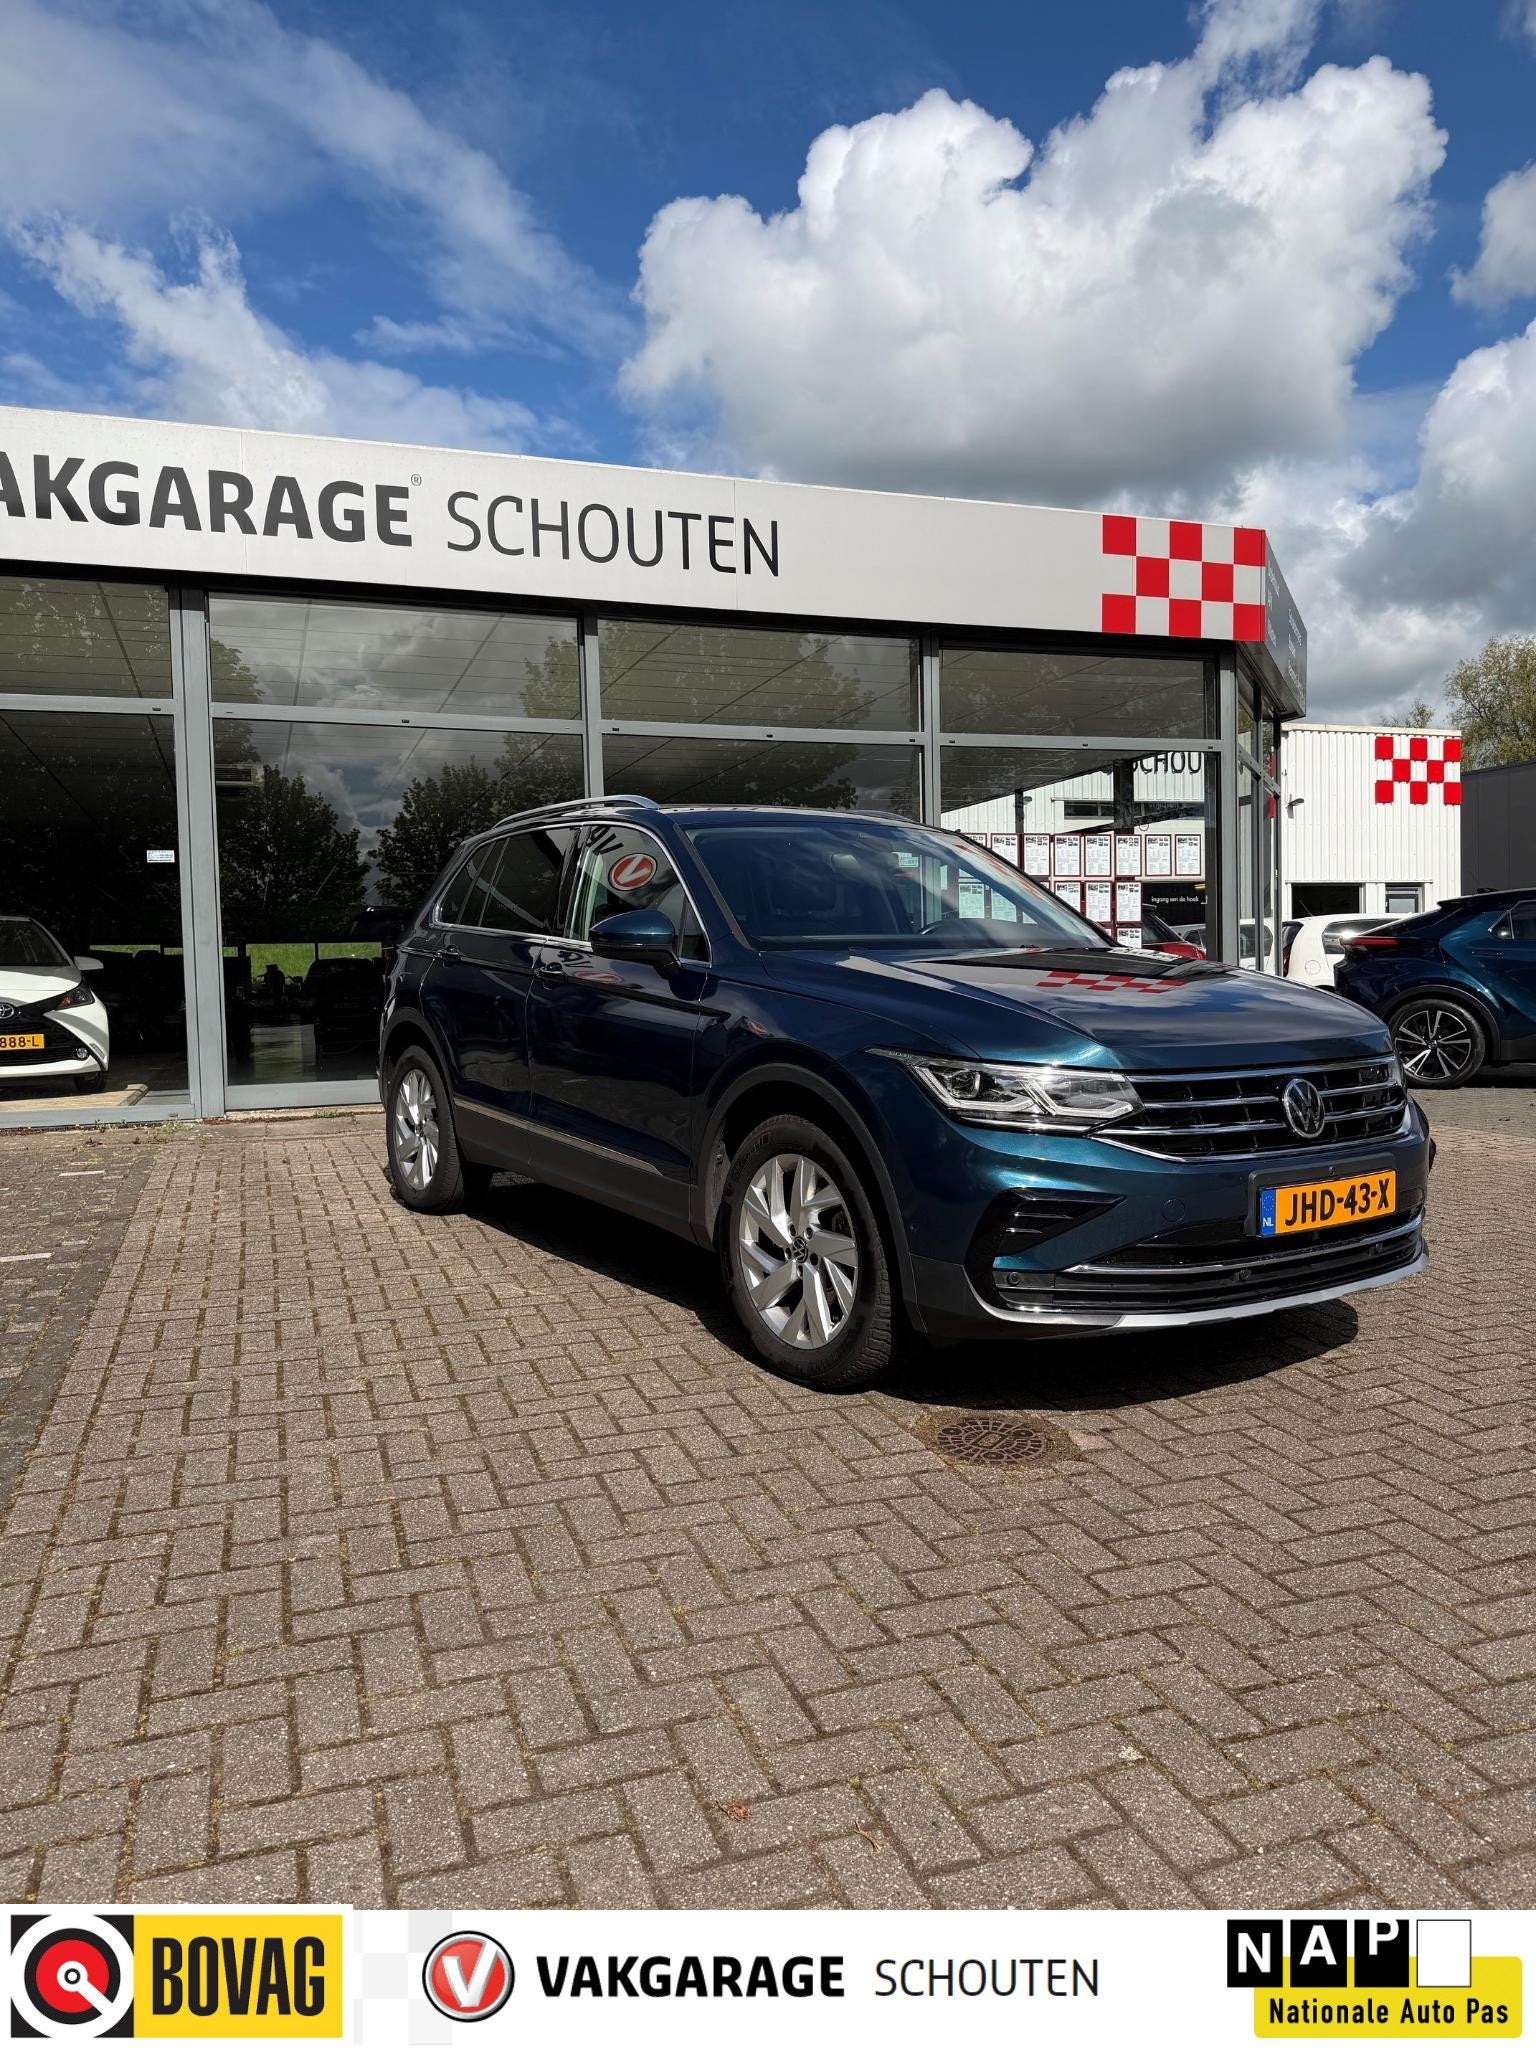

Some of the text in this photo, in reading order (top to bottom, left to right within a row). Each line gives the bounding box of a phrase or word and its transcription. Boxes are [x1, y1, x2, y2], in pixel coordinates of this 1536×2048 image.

[447, 490, 780, 577] SCHOUTEN
[0, 1036, 40, 1048] 888-L
[1285, 1178, 1389, 1226] JHD-43-X
[1262, 1217, 1274, 1227] NL
